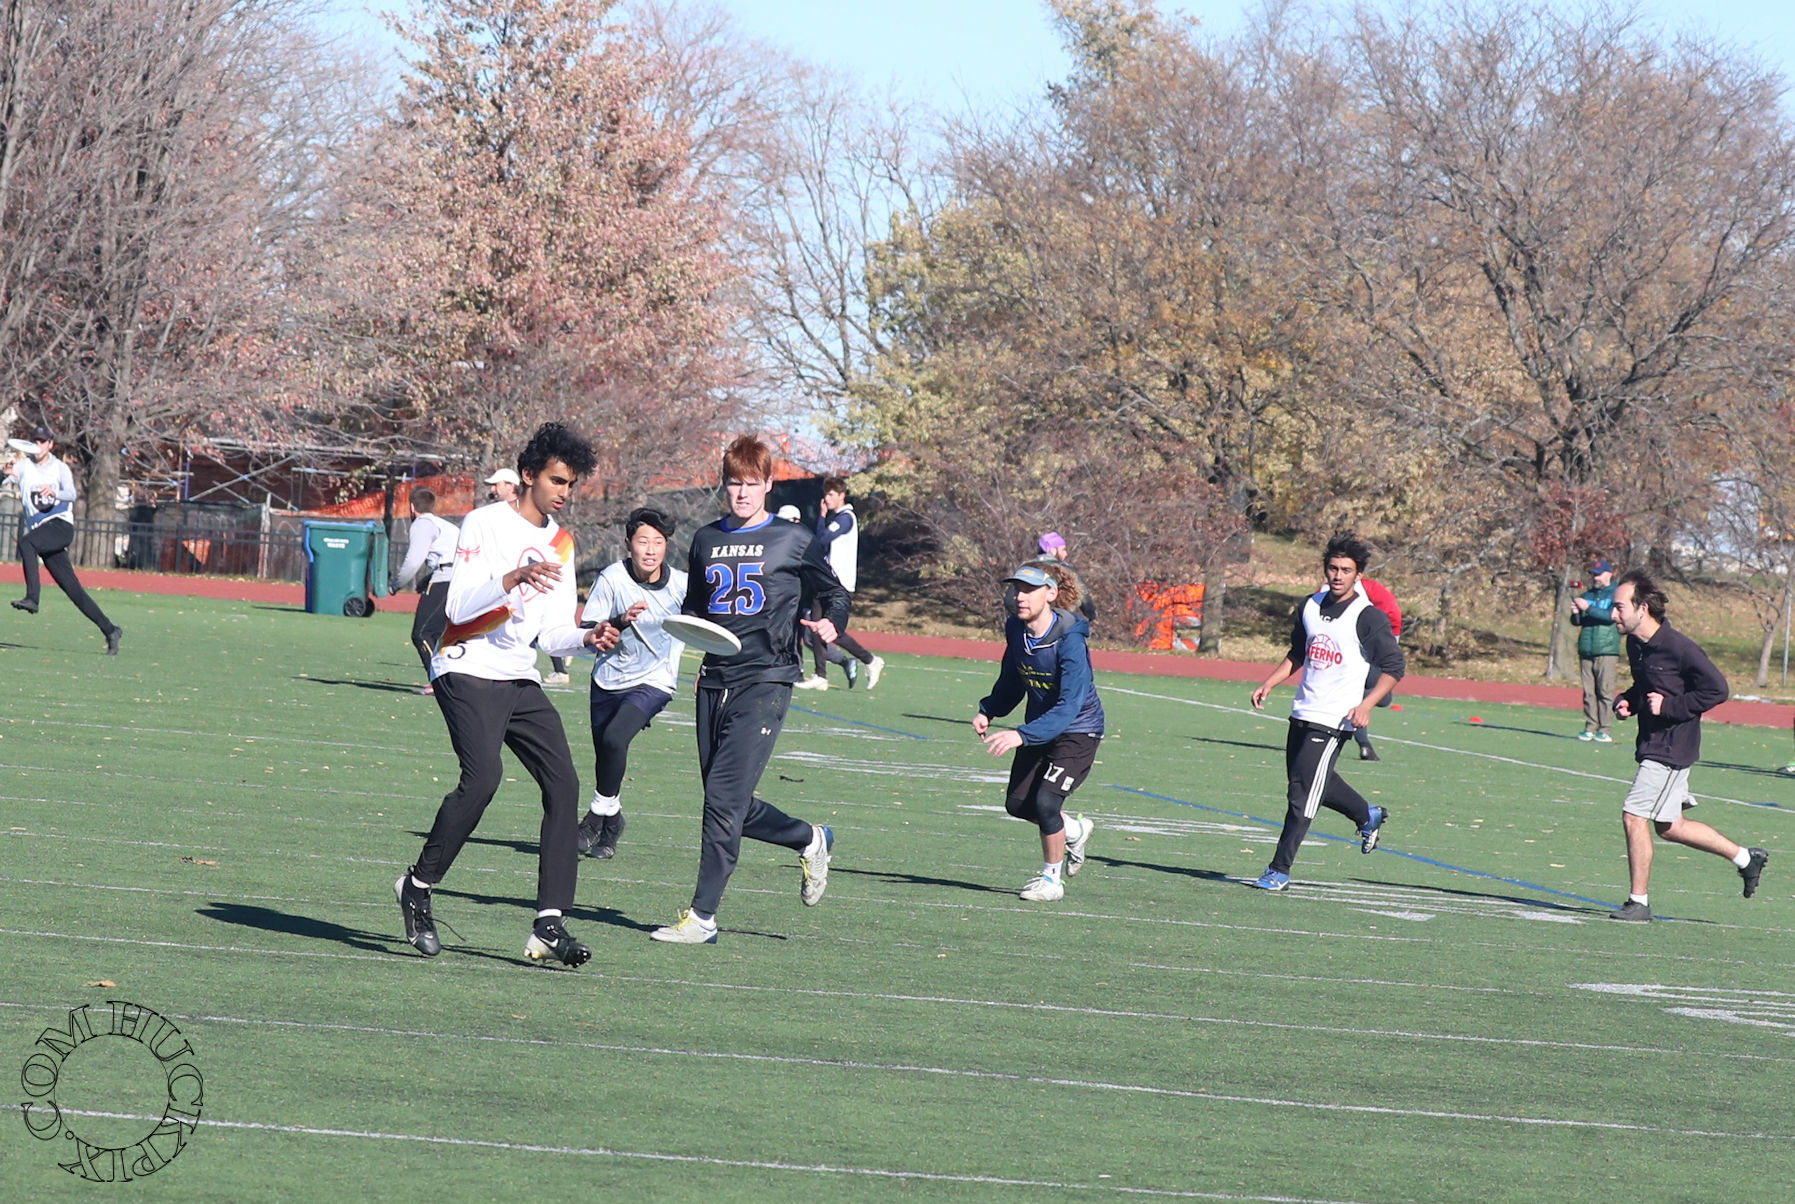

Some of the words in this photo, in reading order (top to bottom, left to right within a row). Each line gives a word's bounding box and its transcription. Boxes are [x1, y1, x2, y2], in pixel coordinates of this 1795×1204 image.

[710, 544, 764, 559] KANSAS
[705, 561, 766, 616] 25
[1043, 762, 1065, 783] 17
